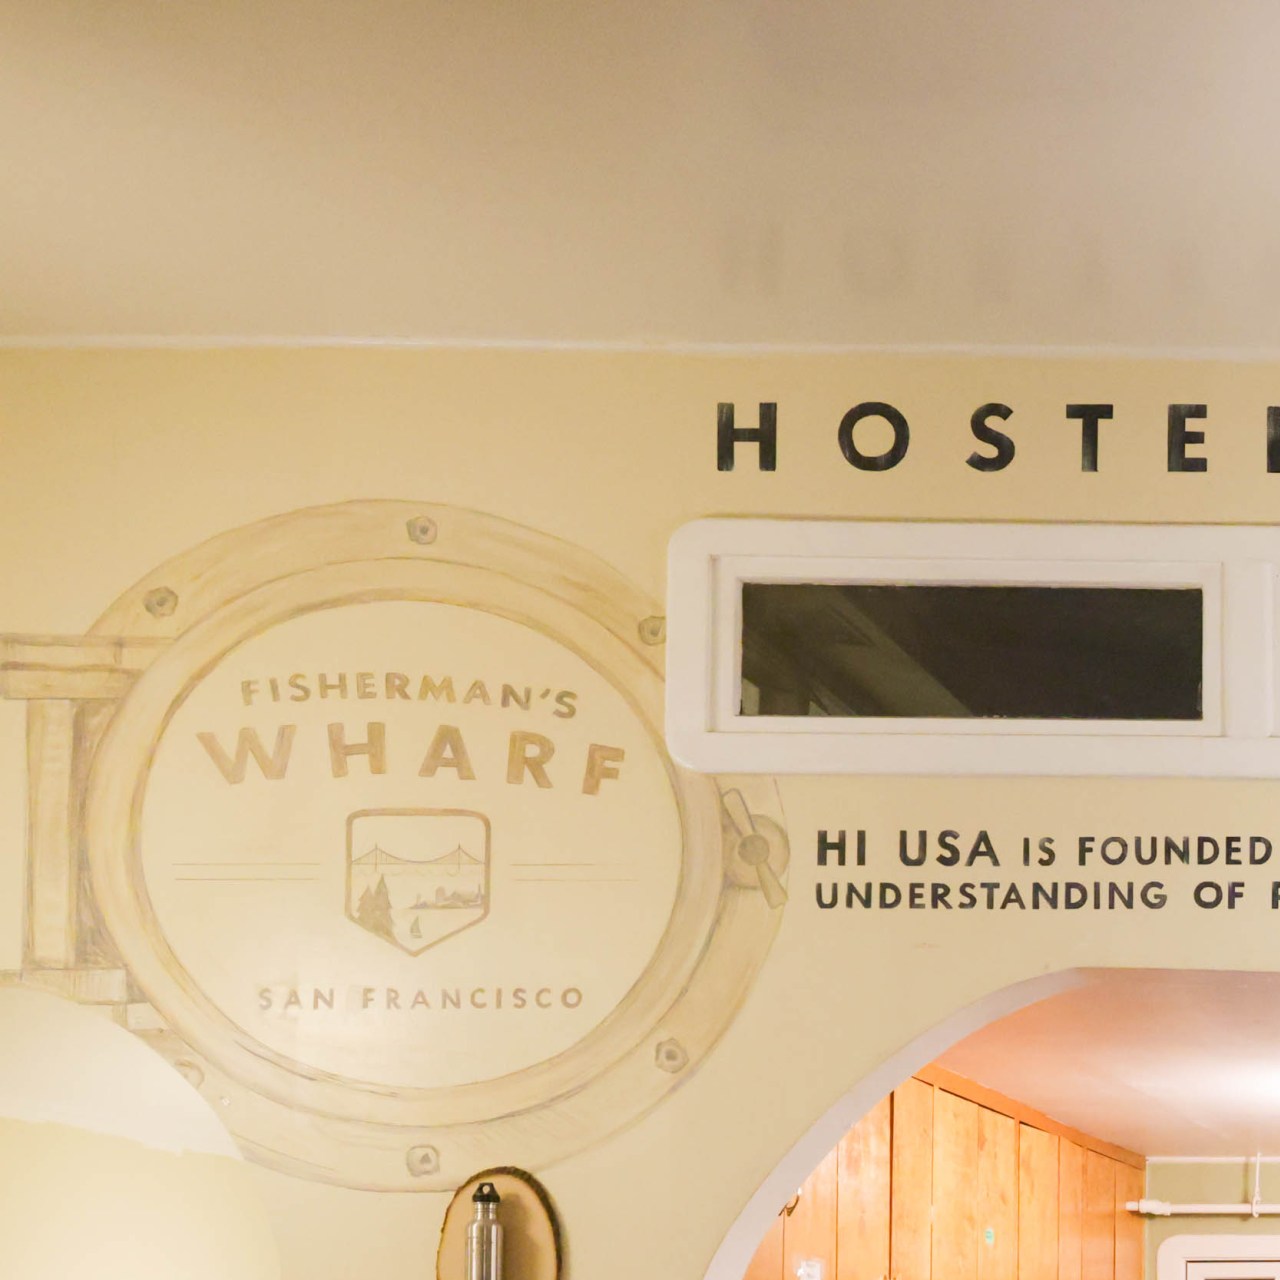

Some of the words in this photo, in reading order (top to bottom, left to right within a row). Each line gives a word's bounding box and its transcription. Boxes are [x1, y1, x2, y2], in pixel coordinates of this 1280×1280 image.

[241, 672, 578, 719] FISHERMAN'S
[197, 722, 625, 796] WHARF
[816, 830, 866, 866] HI
[899, 830, 1001, 867] USA
[1022, 837, 1056, 867] IS
[1078, 836, 1273, 866] FOUNDED
[815, 881, 1168, 910] UNDERSTANDING
[1193, 881, 1245, 909] OF
[258, 987, 335, 1010] SAN
[362, 986, 584, 1010] FRANCISCO
